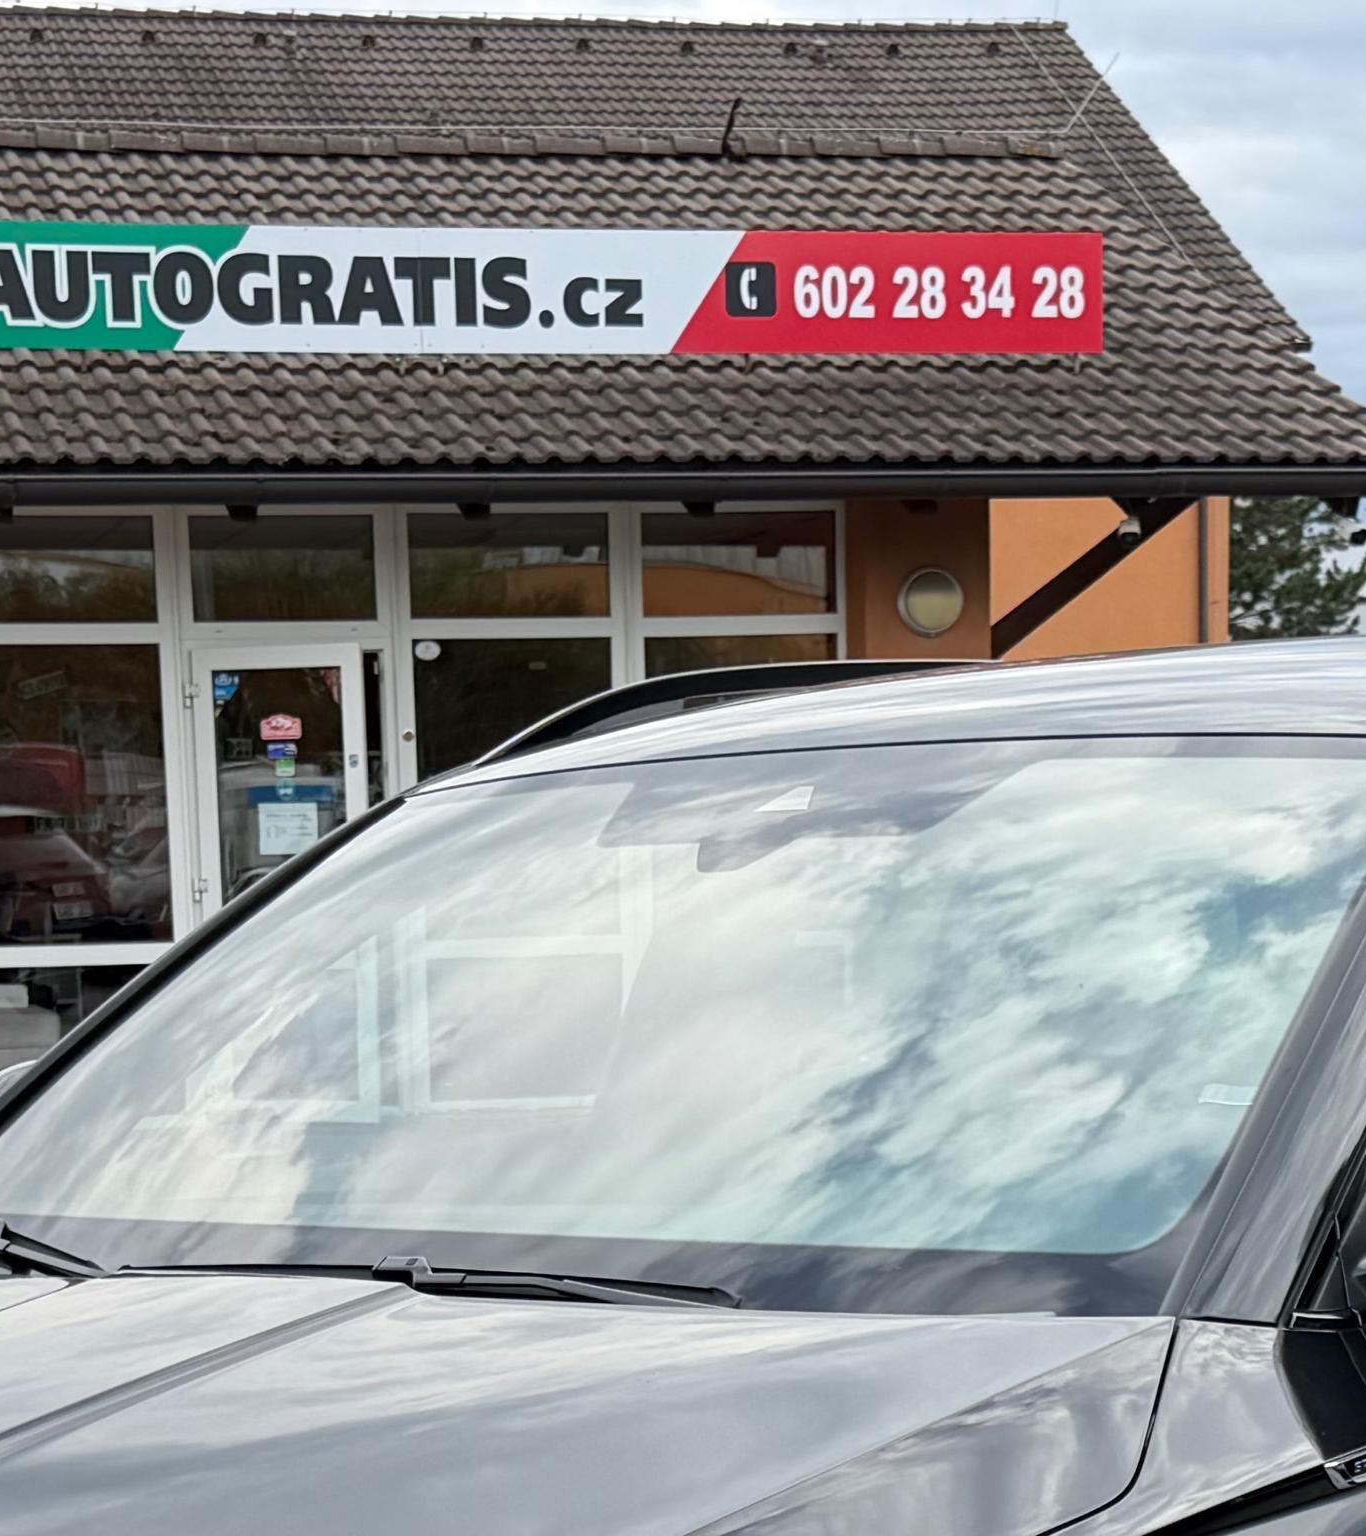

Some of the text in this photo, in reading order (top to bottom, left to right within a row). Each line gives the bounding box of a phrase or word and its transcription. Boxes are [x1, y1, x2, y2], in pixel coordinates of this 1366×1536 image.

[793, 264, 1085, 319] 602 28 34 28
